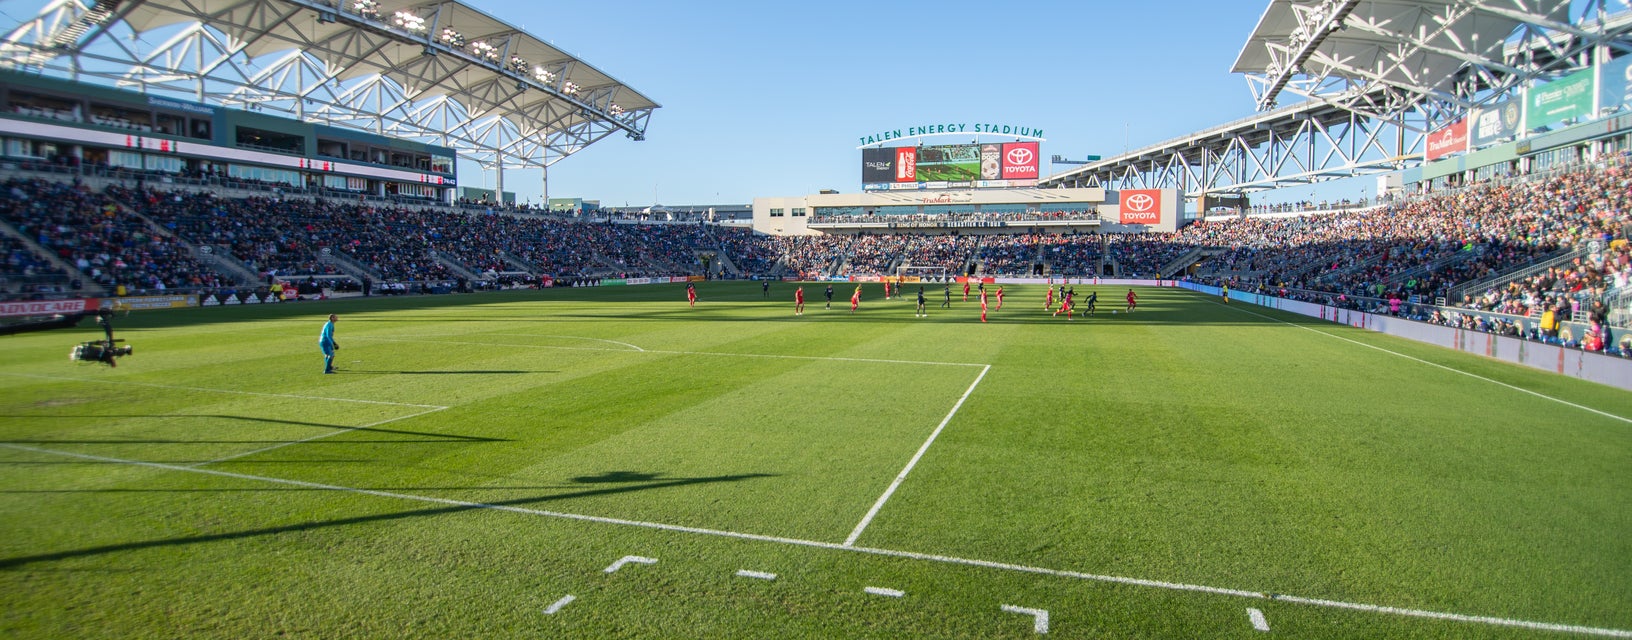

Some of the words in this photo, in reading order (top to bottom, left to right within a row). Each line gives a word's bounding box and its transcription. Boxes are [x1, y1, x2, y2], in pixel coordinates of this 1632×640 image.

[860, 129, 901, 145] TALEN
[910, 123, 966, 136] ENERGY
[975, 123, 1043, 138] STADIUM
[905, 151, 915, 178] Coca-Cola
[1004, 165, 1036, 173] TOYOTA
[922, 196, 951, 204] TruMark
[1124, 212, 1156, 220] TOYOTA
